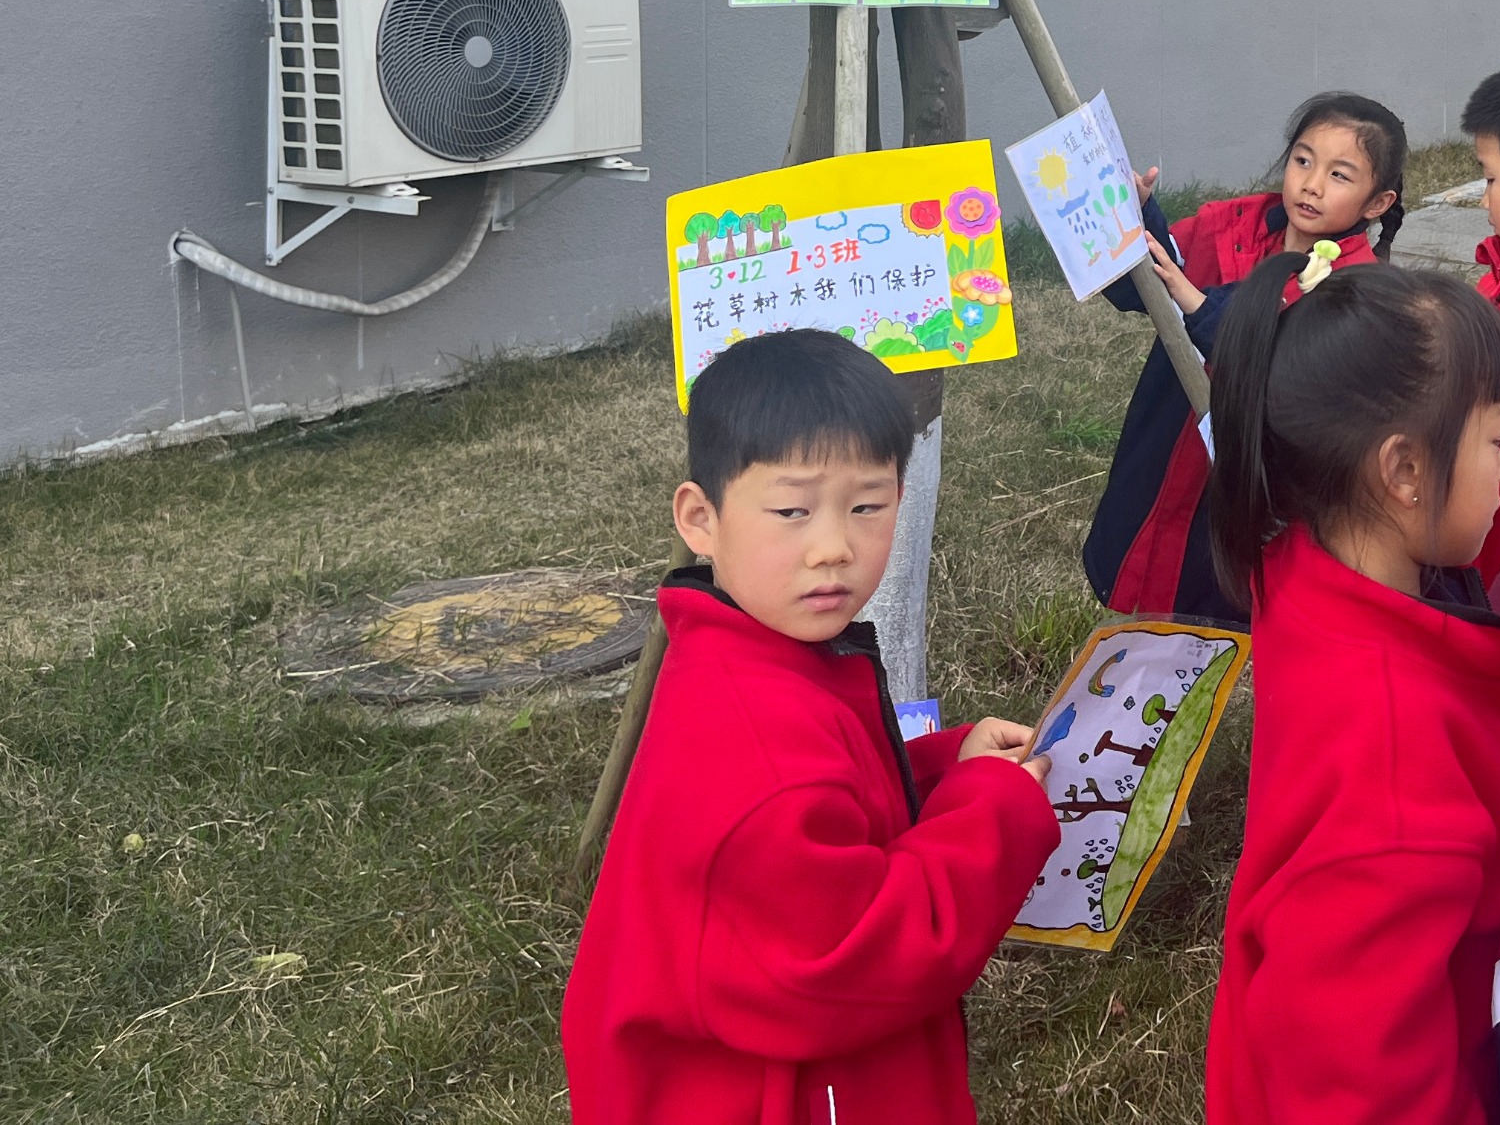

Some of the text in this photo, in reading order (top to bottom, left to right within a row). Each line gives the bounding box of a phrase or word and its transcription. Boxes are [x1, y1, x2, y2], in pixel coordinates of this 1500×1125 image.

[692, 264, 937, 332] 花草树木我们保护
